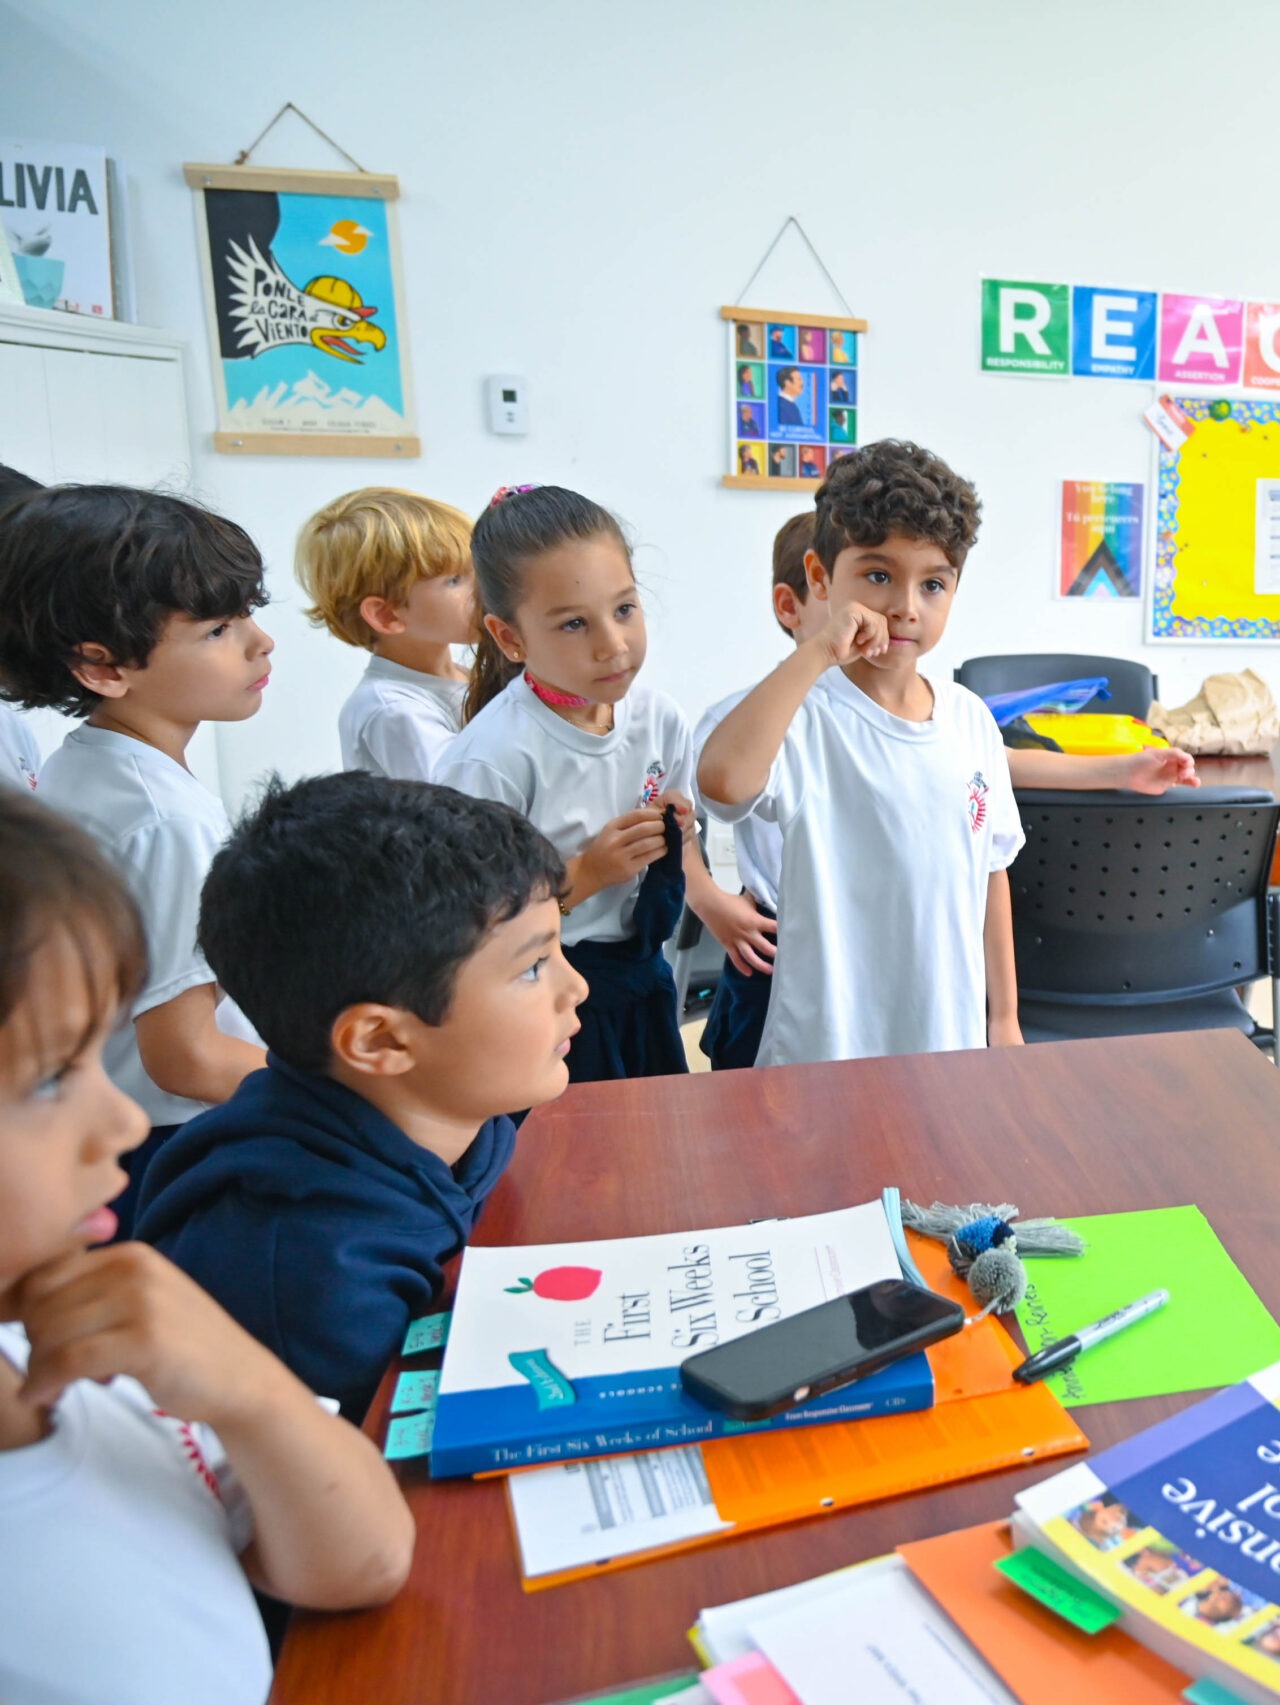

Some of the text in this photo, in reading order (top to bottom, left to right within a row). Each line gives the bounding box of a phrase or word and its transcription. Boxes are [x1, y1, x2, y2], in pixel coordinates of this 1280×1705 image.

[986, 356, 1065, 370] RESPONSIBILITY
[1091, 363, 1135, 376] EMPATHY
[1175, 369, 1225, 382] ASSERTION
[667, 1244, 720, 1349] Six Weeks
[728, 1250, 782, 1323] School
[573, 1319, 591, 1347] THE
[604, 1290, 651, 1344] First
[526, 1442, 562, 1459] First
[566, 1438, 590, 1452] Six
[595, 1430, 643, 1448] Weeks
[646, 1427, 661, 1441] of
[665, 1420, 713, 1437] School
